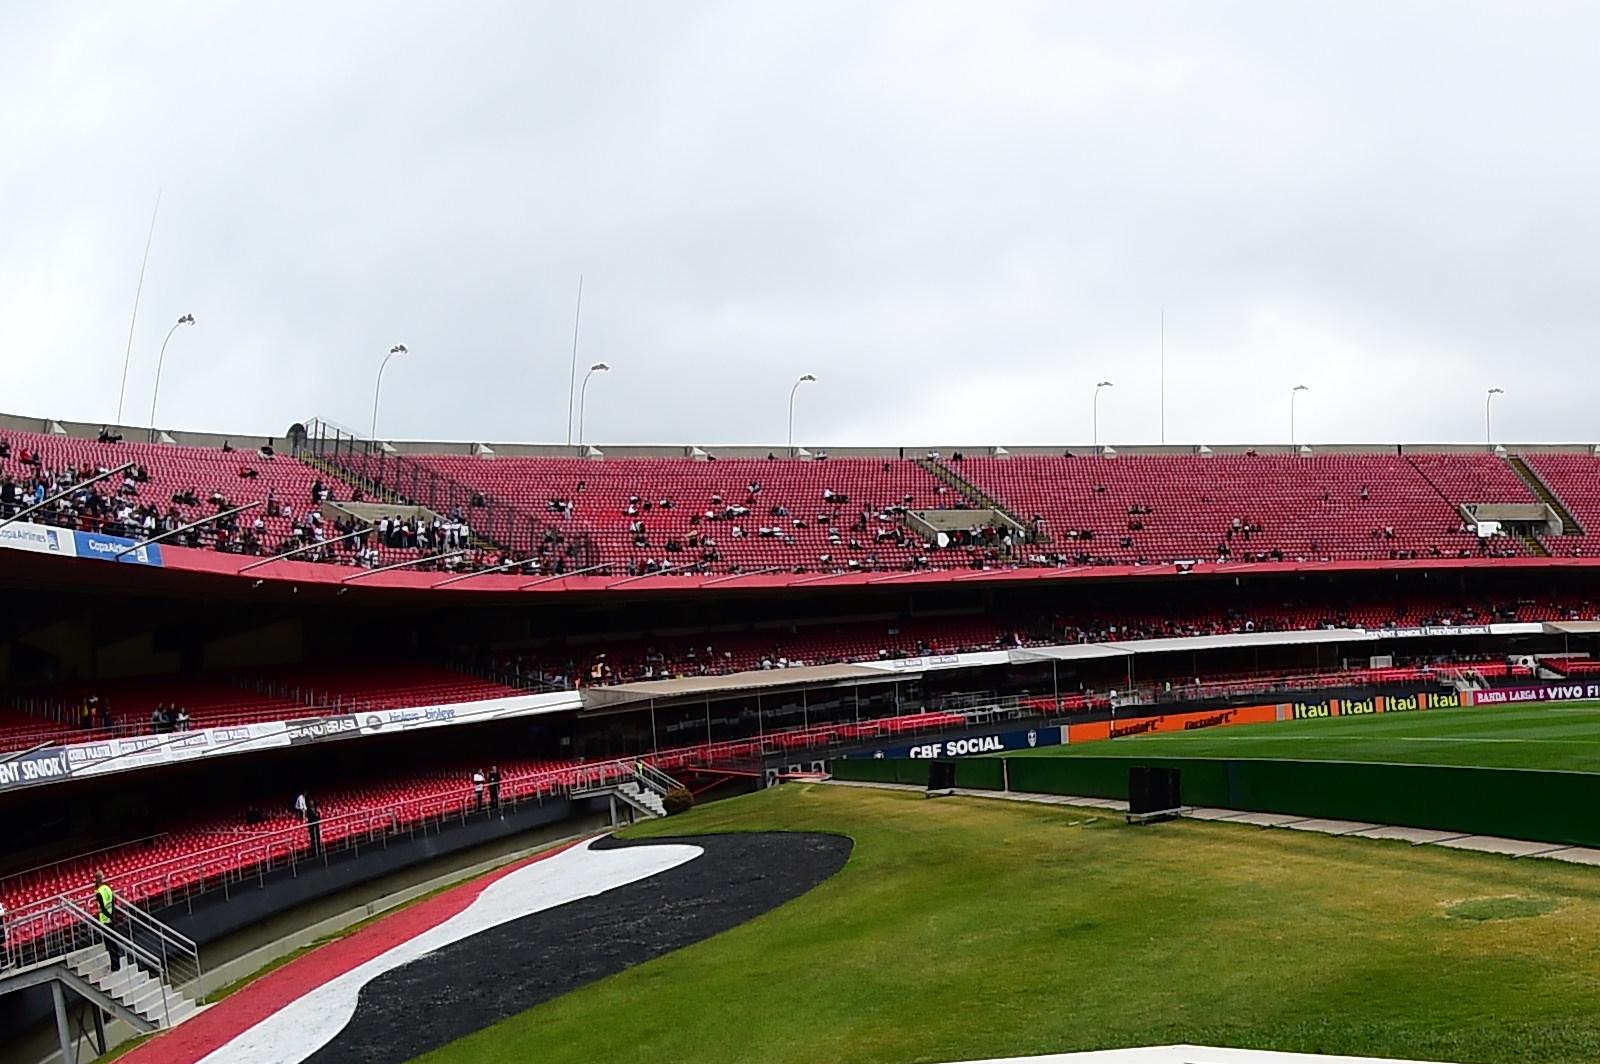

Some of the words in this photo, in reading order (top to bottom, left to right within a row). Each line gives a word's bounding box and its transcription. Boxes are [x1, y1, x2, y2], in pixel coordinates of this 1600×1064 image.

[1386, 694, 1416, 712] Itaú
[1428, 692, 1459, 708] Itaú
[1476, 691, 1507, 703] BANDA
[1509, 689, 1537, 701] LARGA
[1547, 685, 1583, 699] VIVO
[1295, 702, 1329, 719] Itaú
[1341, 697, 1374, 715] Itaú
[909, 744, 943, 759] CBF
[946, 735, 1005, 757] SOCIAL
[21, 757, 63, 780] SENIOR
